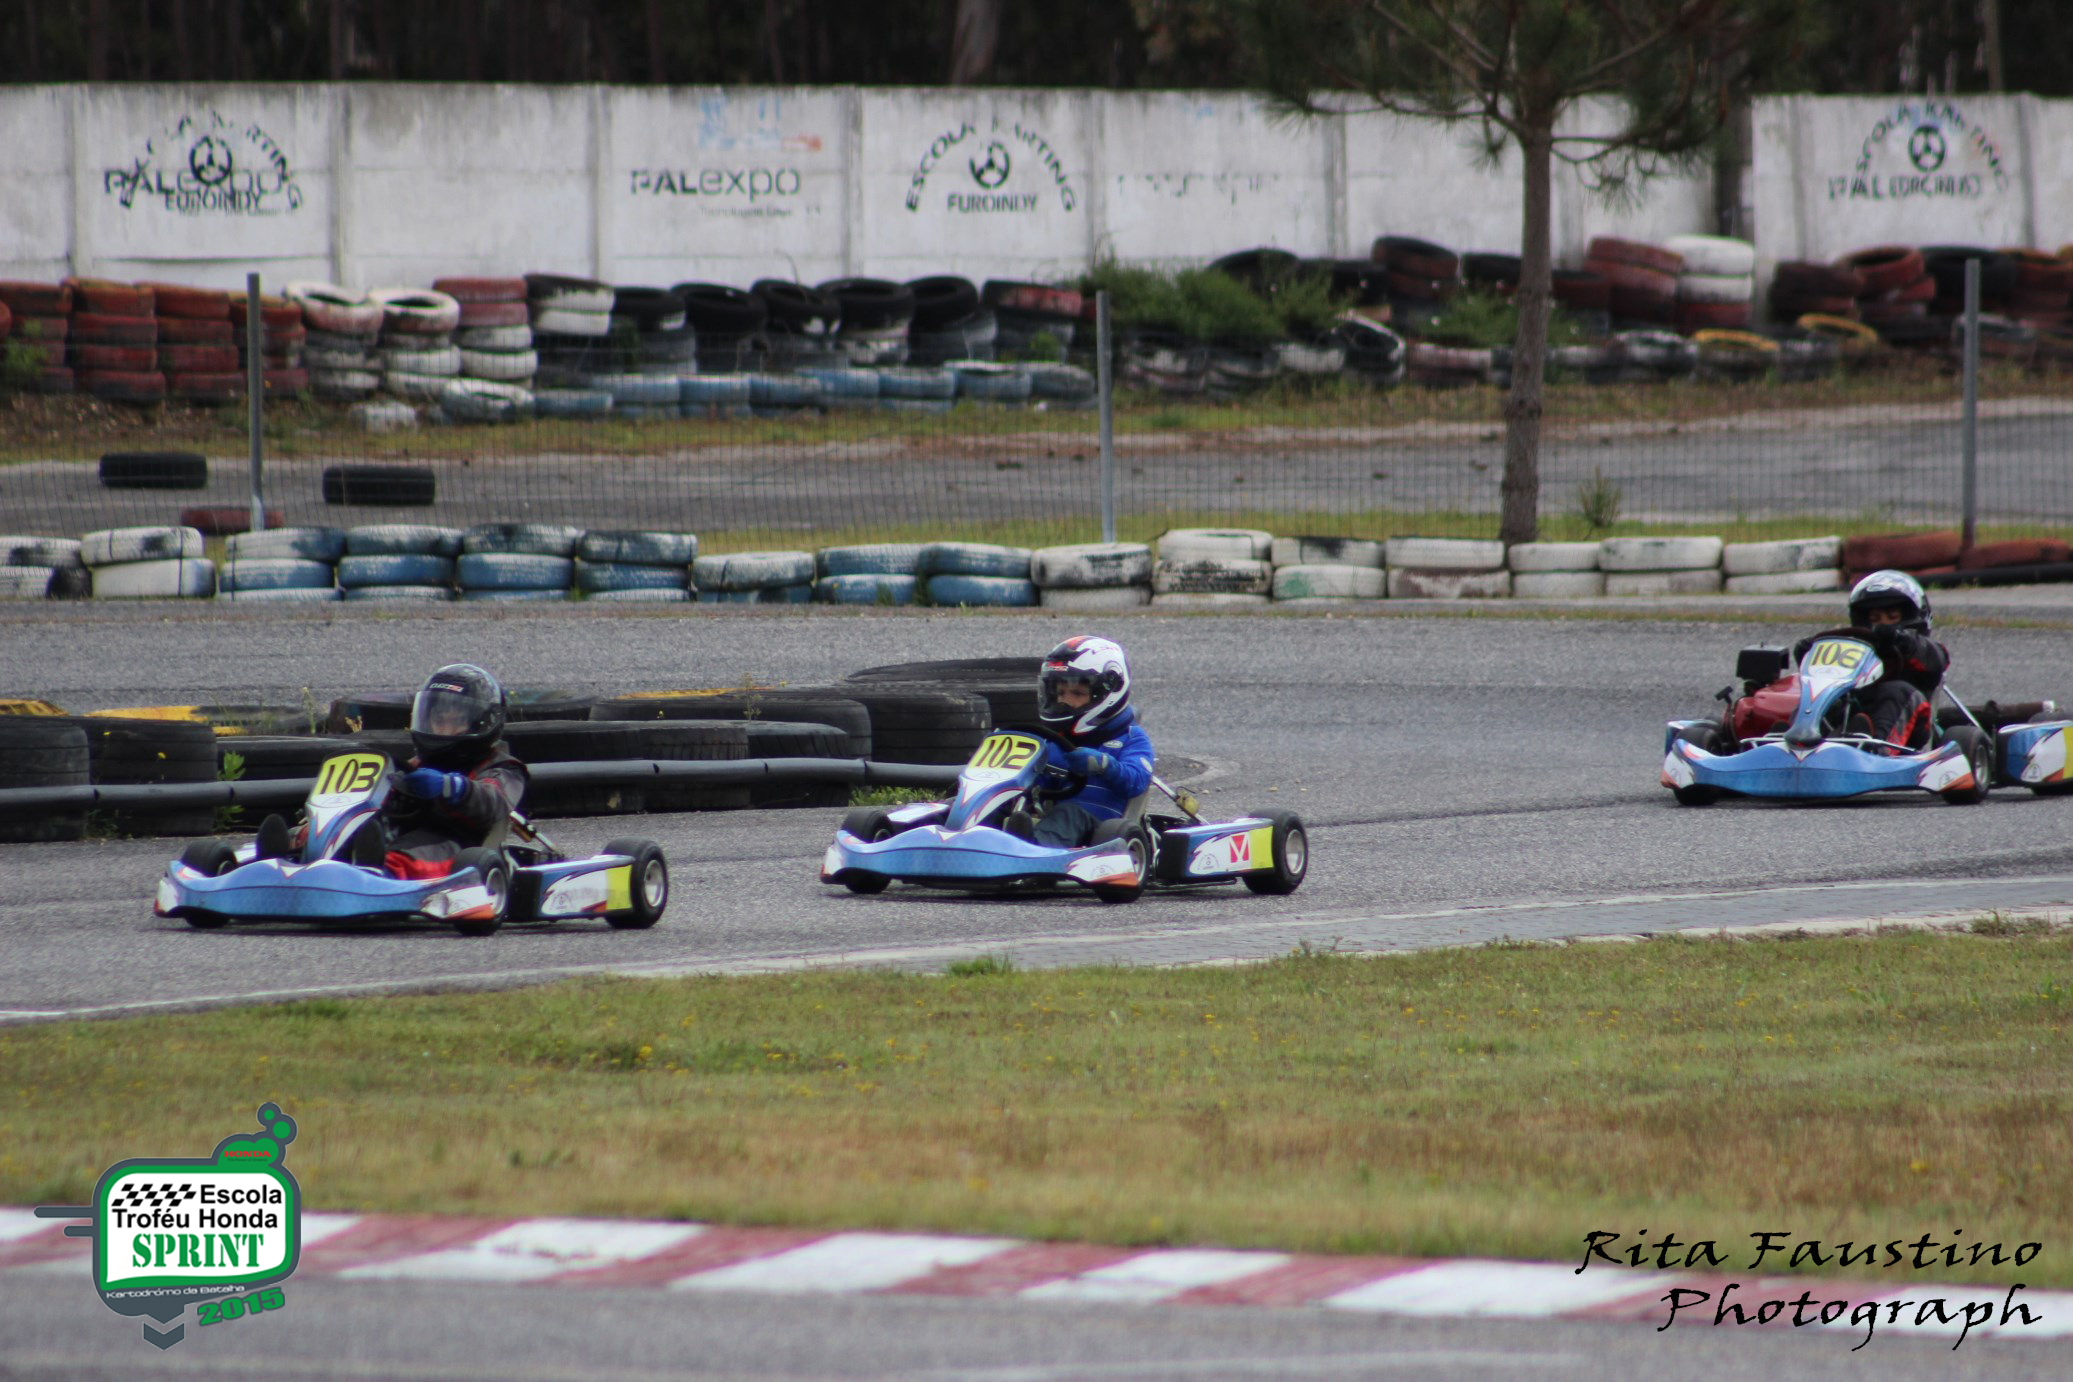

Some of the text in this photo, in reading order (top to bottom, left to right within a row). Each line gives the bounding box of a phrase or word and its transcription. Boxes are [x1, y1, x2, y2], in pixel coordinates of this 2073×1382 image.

[1811, 642, 1865, 669] 106
[974, 736, 1037, 770] 102
[319, 758, 380, 794] 103
